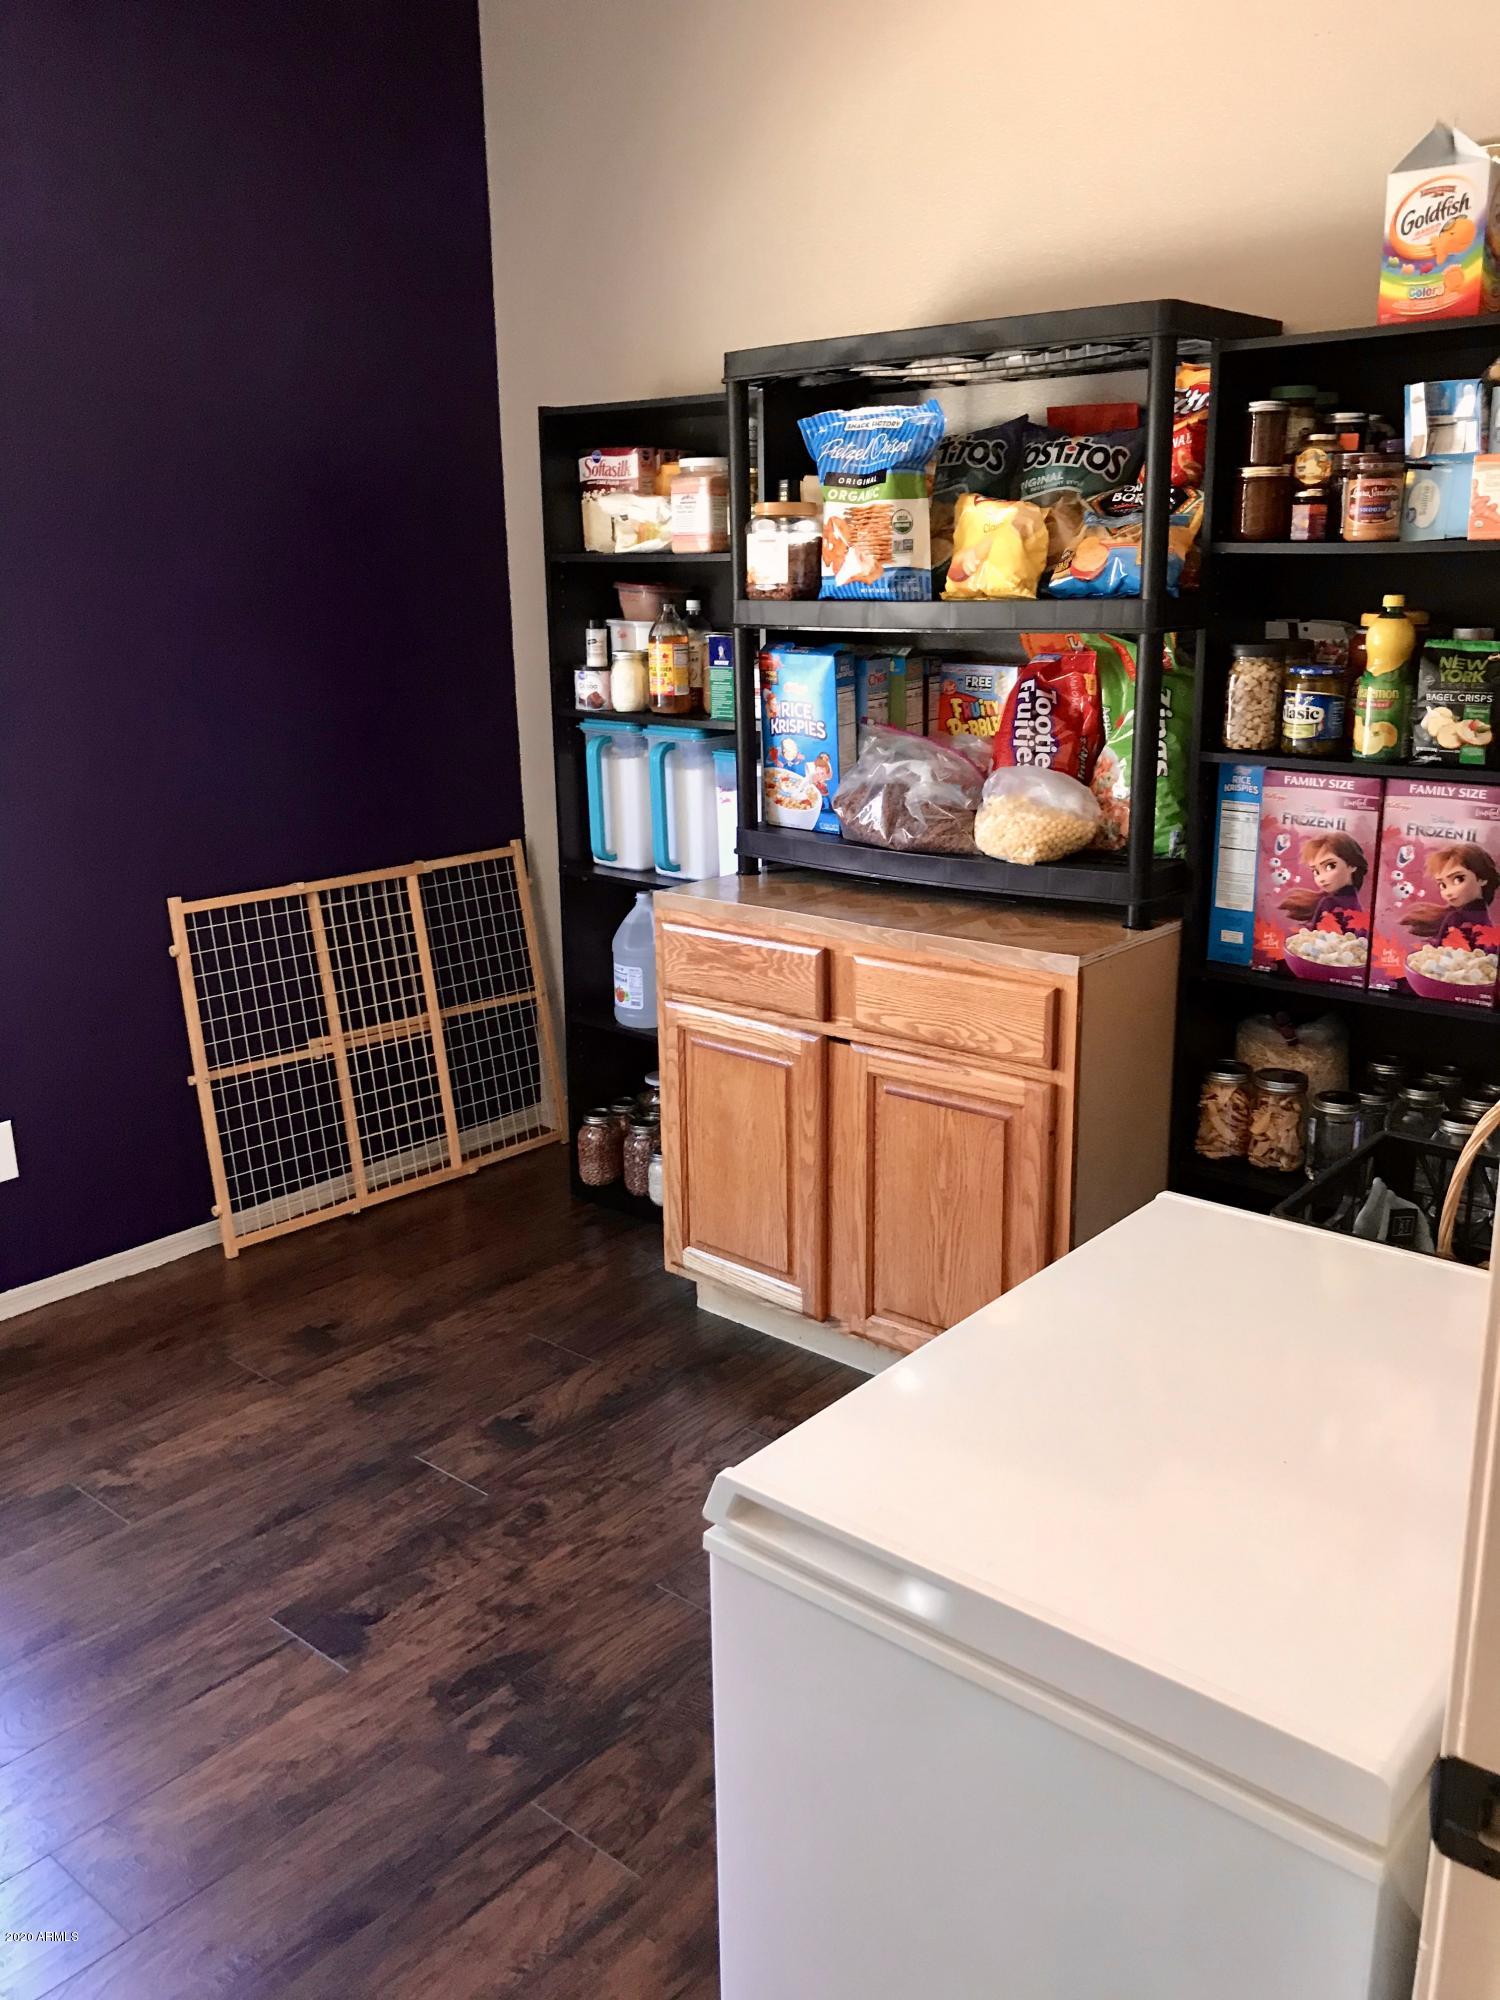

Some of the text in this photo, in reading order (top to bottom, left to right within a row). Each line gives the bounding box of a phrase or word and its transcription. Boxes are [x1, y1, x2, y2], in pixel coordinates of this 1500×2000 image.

[1401, 193, 1469, 236] Goldfish
[817, 433, 912, 470] Pretzel Crisps
[583, 457, 631, 478] Softasilk
[838, 475, 877, 486] ORIGINAL
[828, 486, 880, 501] ORGANIC
[1112, 492, 1145, 506] BOR
[1440, 654, 1489, 671] NEW
[965, 674, 992, 688] FREE
[1440, 669, 1487, 683] YORK
[1426, 693, 1493, 703] BAGEL CRISPS
[781, 700, 813, 719] RICE
[770, 717, 827, 740] KRISPIES
[1013, 678, 1036, 767] Fruitie
[1034, 688, 1057, 769] Tootie
[1232, 775, 1252, 785] RICE
[1284, 775, 1356, 790] FAMILY SIZE
[1223, 783, 1259, 795] KRISPIES
[1408, 783, 1488, 799] FAMILY SIZE
[1282, 811, 1335, 828] FROZEN
[1406, 822, 1464, 840] FROZEN
